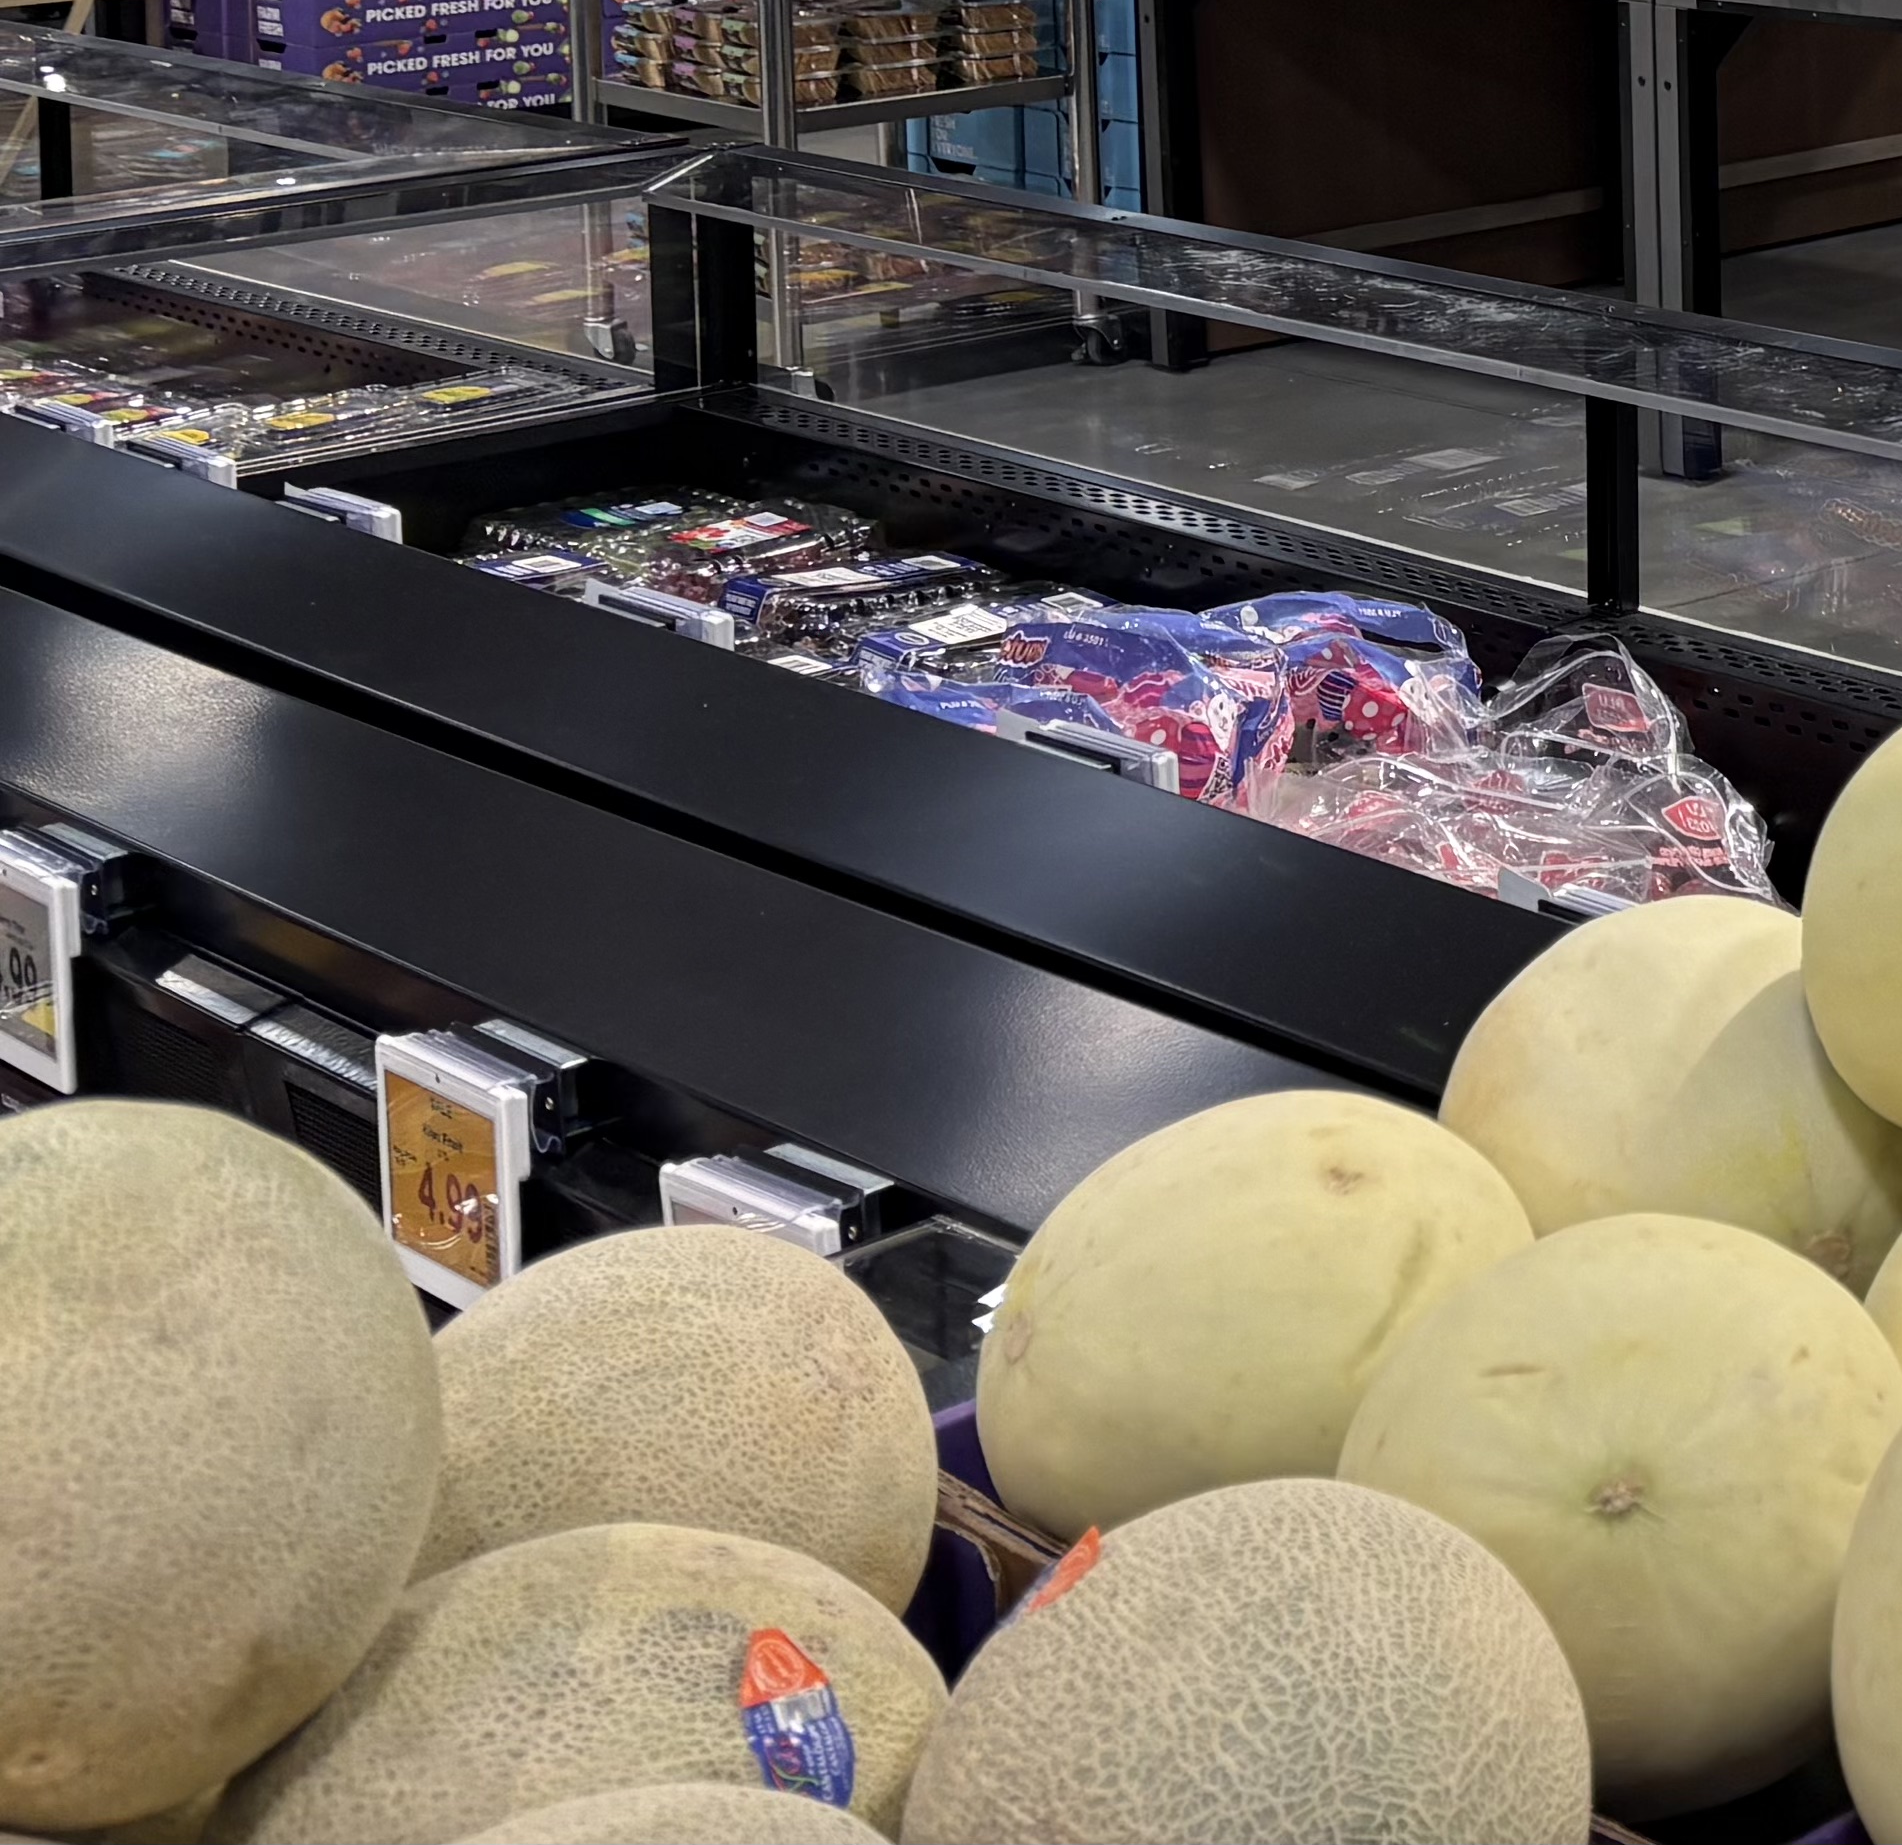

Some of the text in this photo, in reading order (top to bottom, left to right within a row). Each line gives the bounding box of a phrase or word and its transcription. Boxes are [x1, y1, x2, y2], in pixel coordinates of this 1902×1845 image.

[365, 5, 426, 23] PICKED
[430, 0, 479, 15] FRESH
[418, 1162, 487, 1246] 4.99
